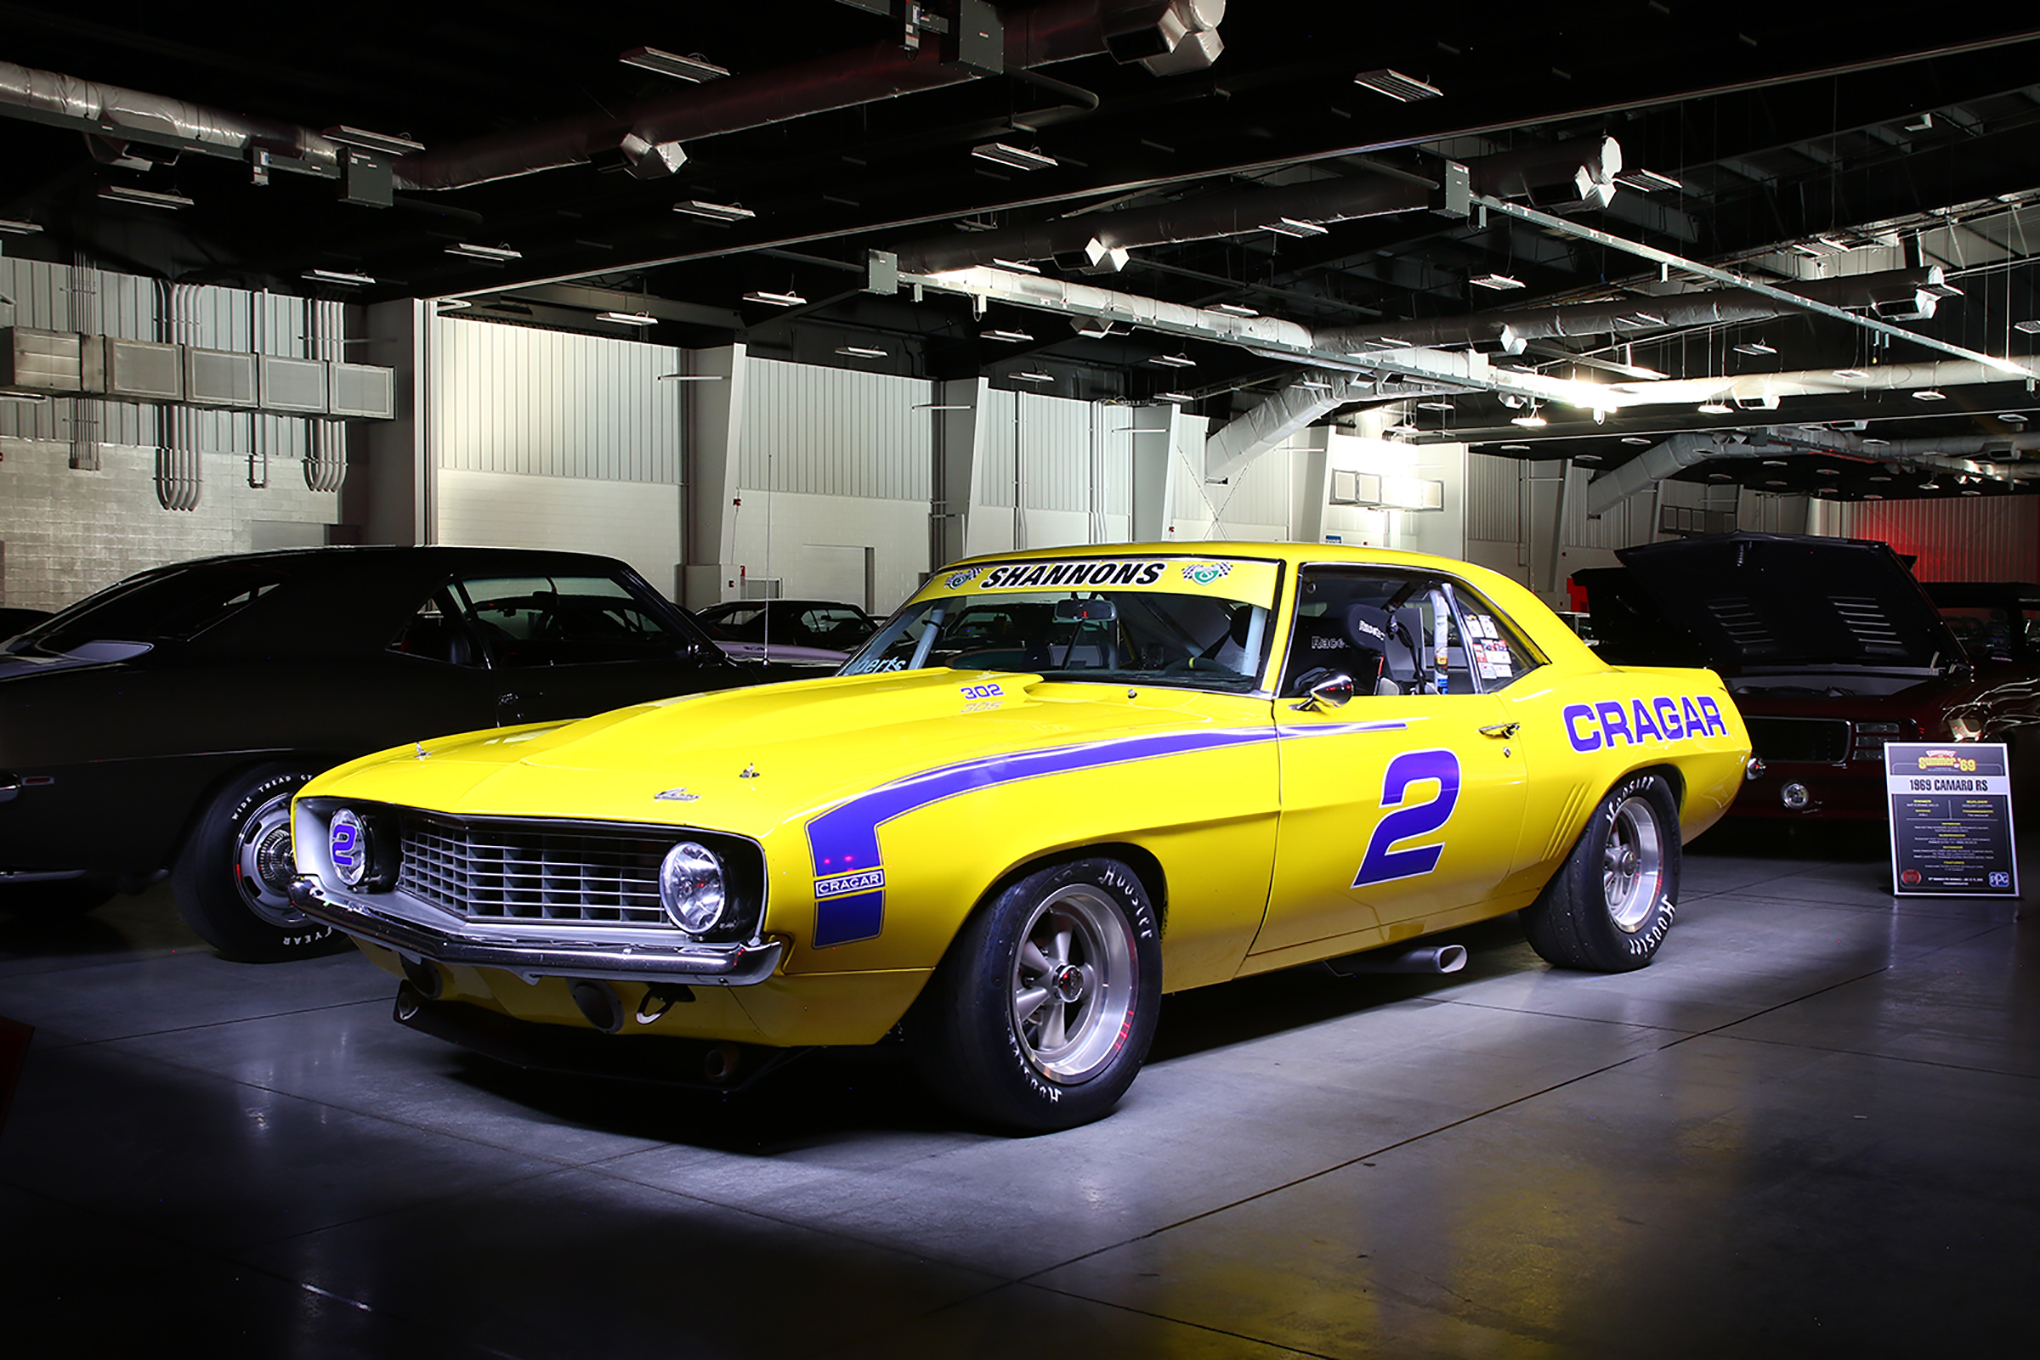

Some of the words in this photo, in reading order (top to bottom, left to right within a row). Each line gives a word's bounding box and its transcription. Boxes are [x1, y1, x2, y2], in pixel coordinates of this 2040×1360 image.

[982, 562, 1166, 588] SHANNONS
[960, 684, 1005, 700] 302
[1562, 695, 1730, 754] CRAGAR
[258, 775, 293, 793] TREAD
[1910, 779, 1932, 791] 1969
[1934, 779, 1973, 791] CAMARO
[1976, 780, 1988, 791] RS
[231, 796, 252, 821] WIDE
[1350, 747, 1462, 889] 2
[332, 823, 357, 868] 2
[818, 873, 881, 894] CRAGAR
